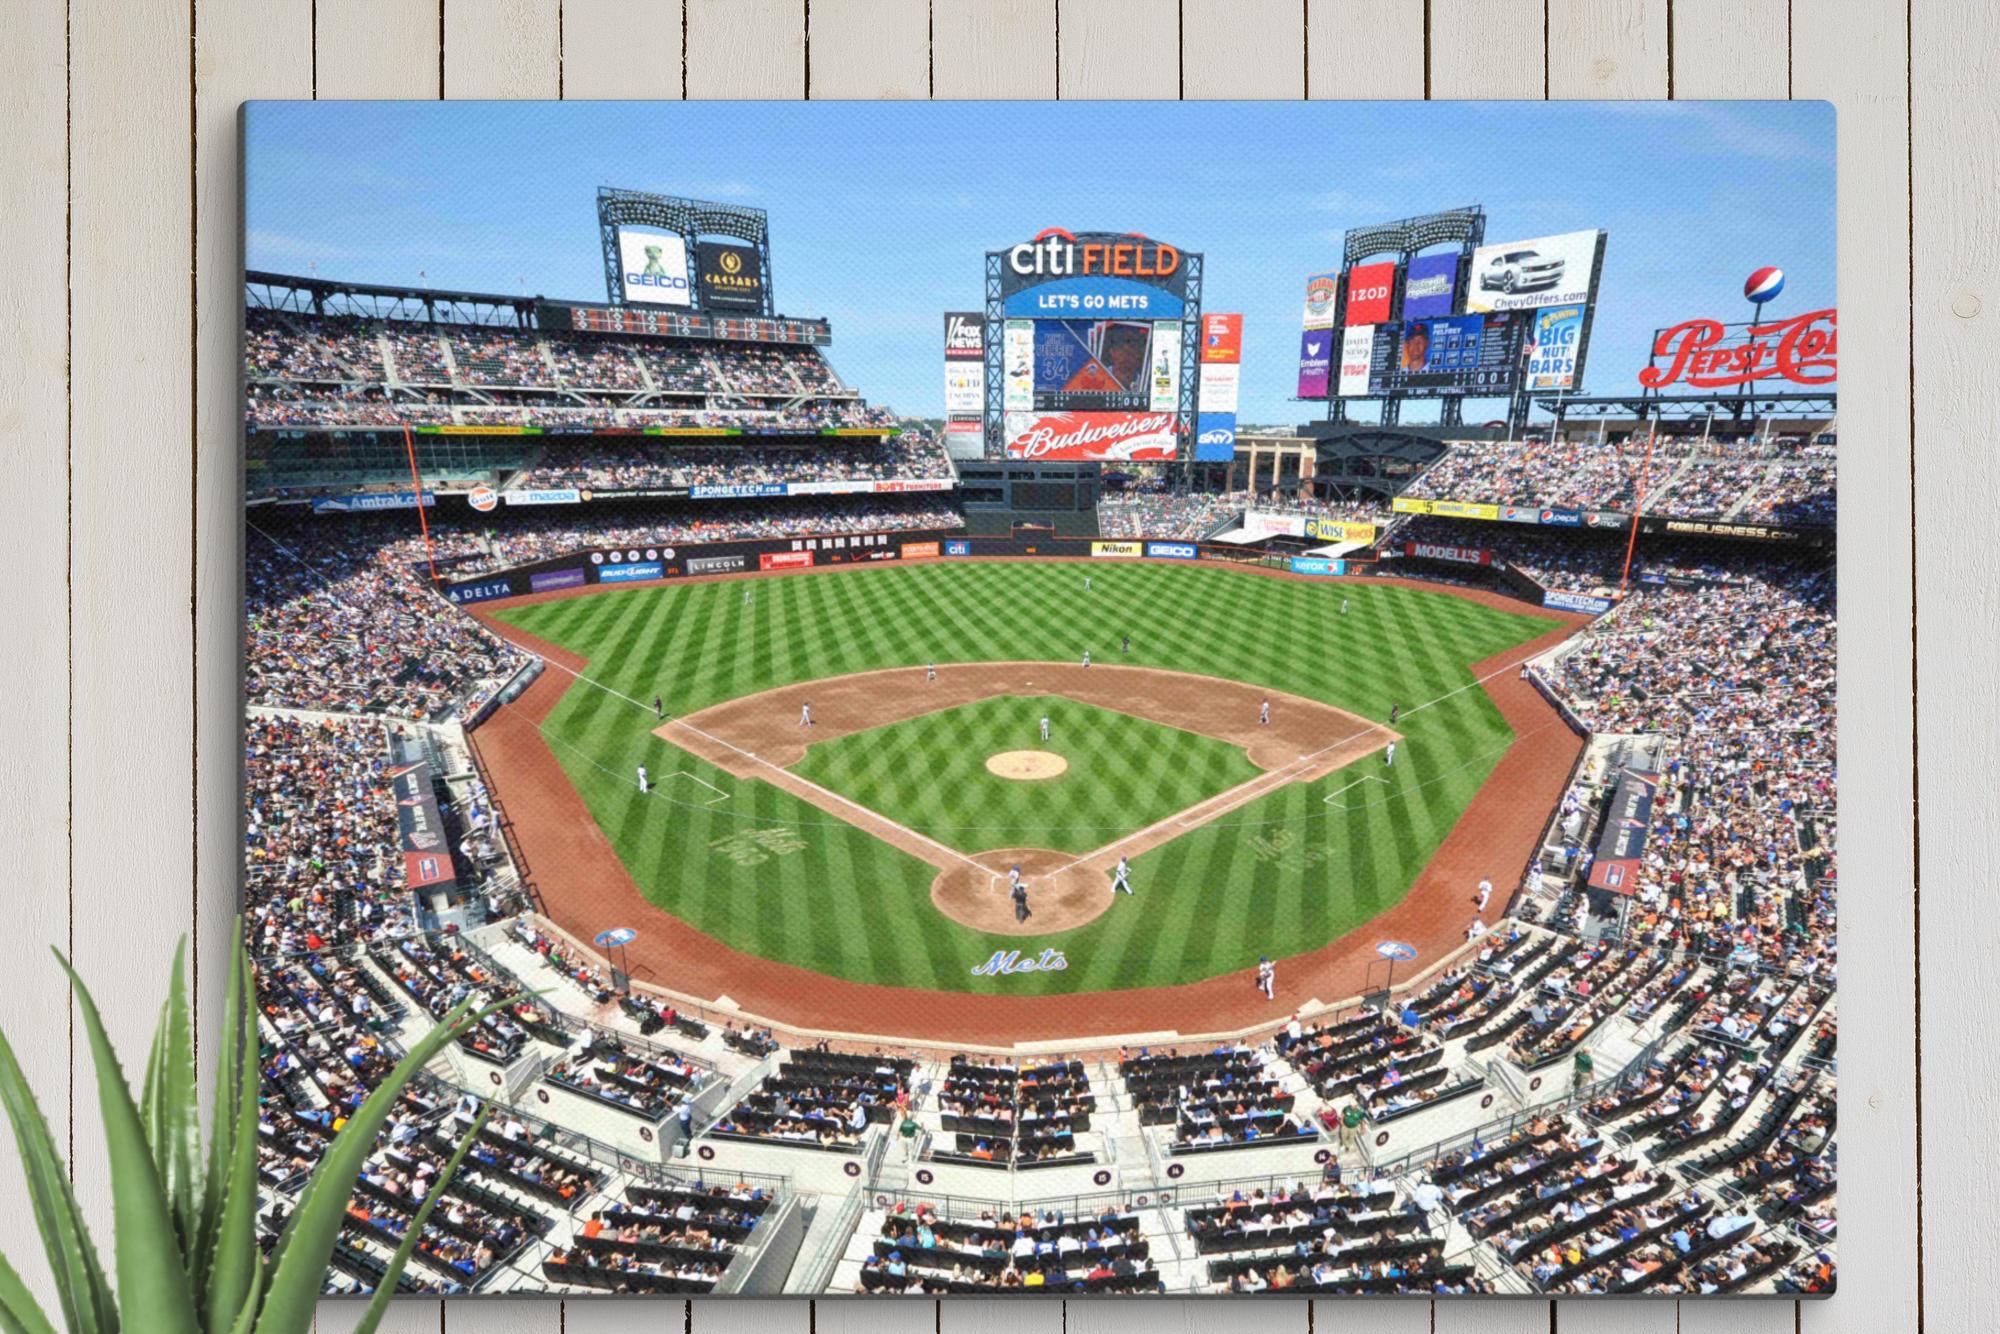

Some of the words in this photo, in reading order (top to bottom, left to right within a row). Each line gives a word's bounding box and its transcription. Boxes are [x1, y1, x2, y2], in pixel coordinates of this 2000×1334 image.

[1010, 236, 1074, 275] citi
[1082, 243, 1179, 276] FIELD
[626, 273, 687, 289] GEICO
[705, 274, 759, 288] CAESARS
[1351, 286, 1388, 302] IZOD
[1494, 291, 1587, 309] ChevyOffers.com
[1039, 295, 1079, 309] LET'S
[1084, 295, 1104, 309] GO
[1109, 295, 1148, 309] METS
[957, 326, 981, 338] FOX
[1539, 325, 1574, 346] BIG
[951, 337, 982, 349] NEWS
[1542, 346, 1567, 358] NUT
[1042, 357, 1069, 381] 34
[1300, 359, 1329, 368] Emblem
[1530, 358, 1573, 374] BARS
[1020, 415, 1172, 458] Budweiser
[1198, 432, 1230, 444] SNY
[875, 482, 905, 491] BOB'S
[351, 494, 435, 509] Amtrak.com
[470, 492, 494, 505] Gulf
[530, 490, 575, 501] mazda
[1553, 514, 1579, 523] pepsi
[1600, 519, 1621, 527] max
[1320, 524, 1344, 537] WISE
[949, 543, 966, 554] citi
[1101, 544, 1132, 553] Nikon
[1150, 545, 1194, 556] GEICO
[1415, 544, 1481, 564] MODELL'S
[694, 560, 744, 569] LINCOLN
[1295, 561, 1326, 570] xerox
[601, 569, 627, 577] BUD
[628, 566, 661, 575] LIGHT
[463, 583, 510, 599] DELTA
[971, 949, 1068, 976] Mets
